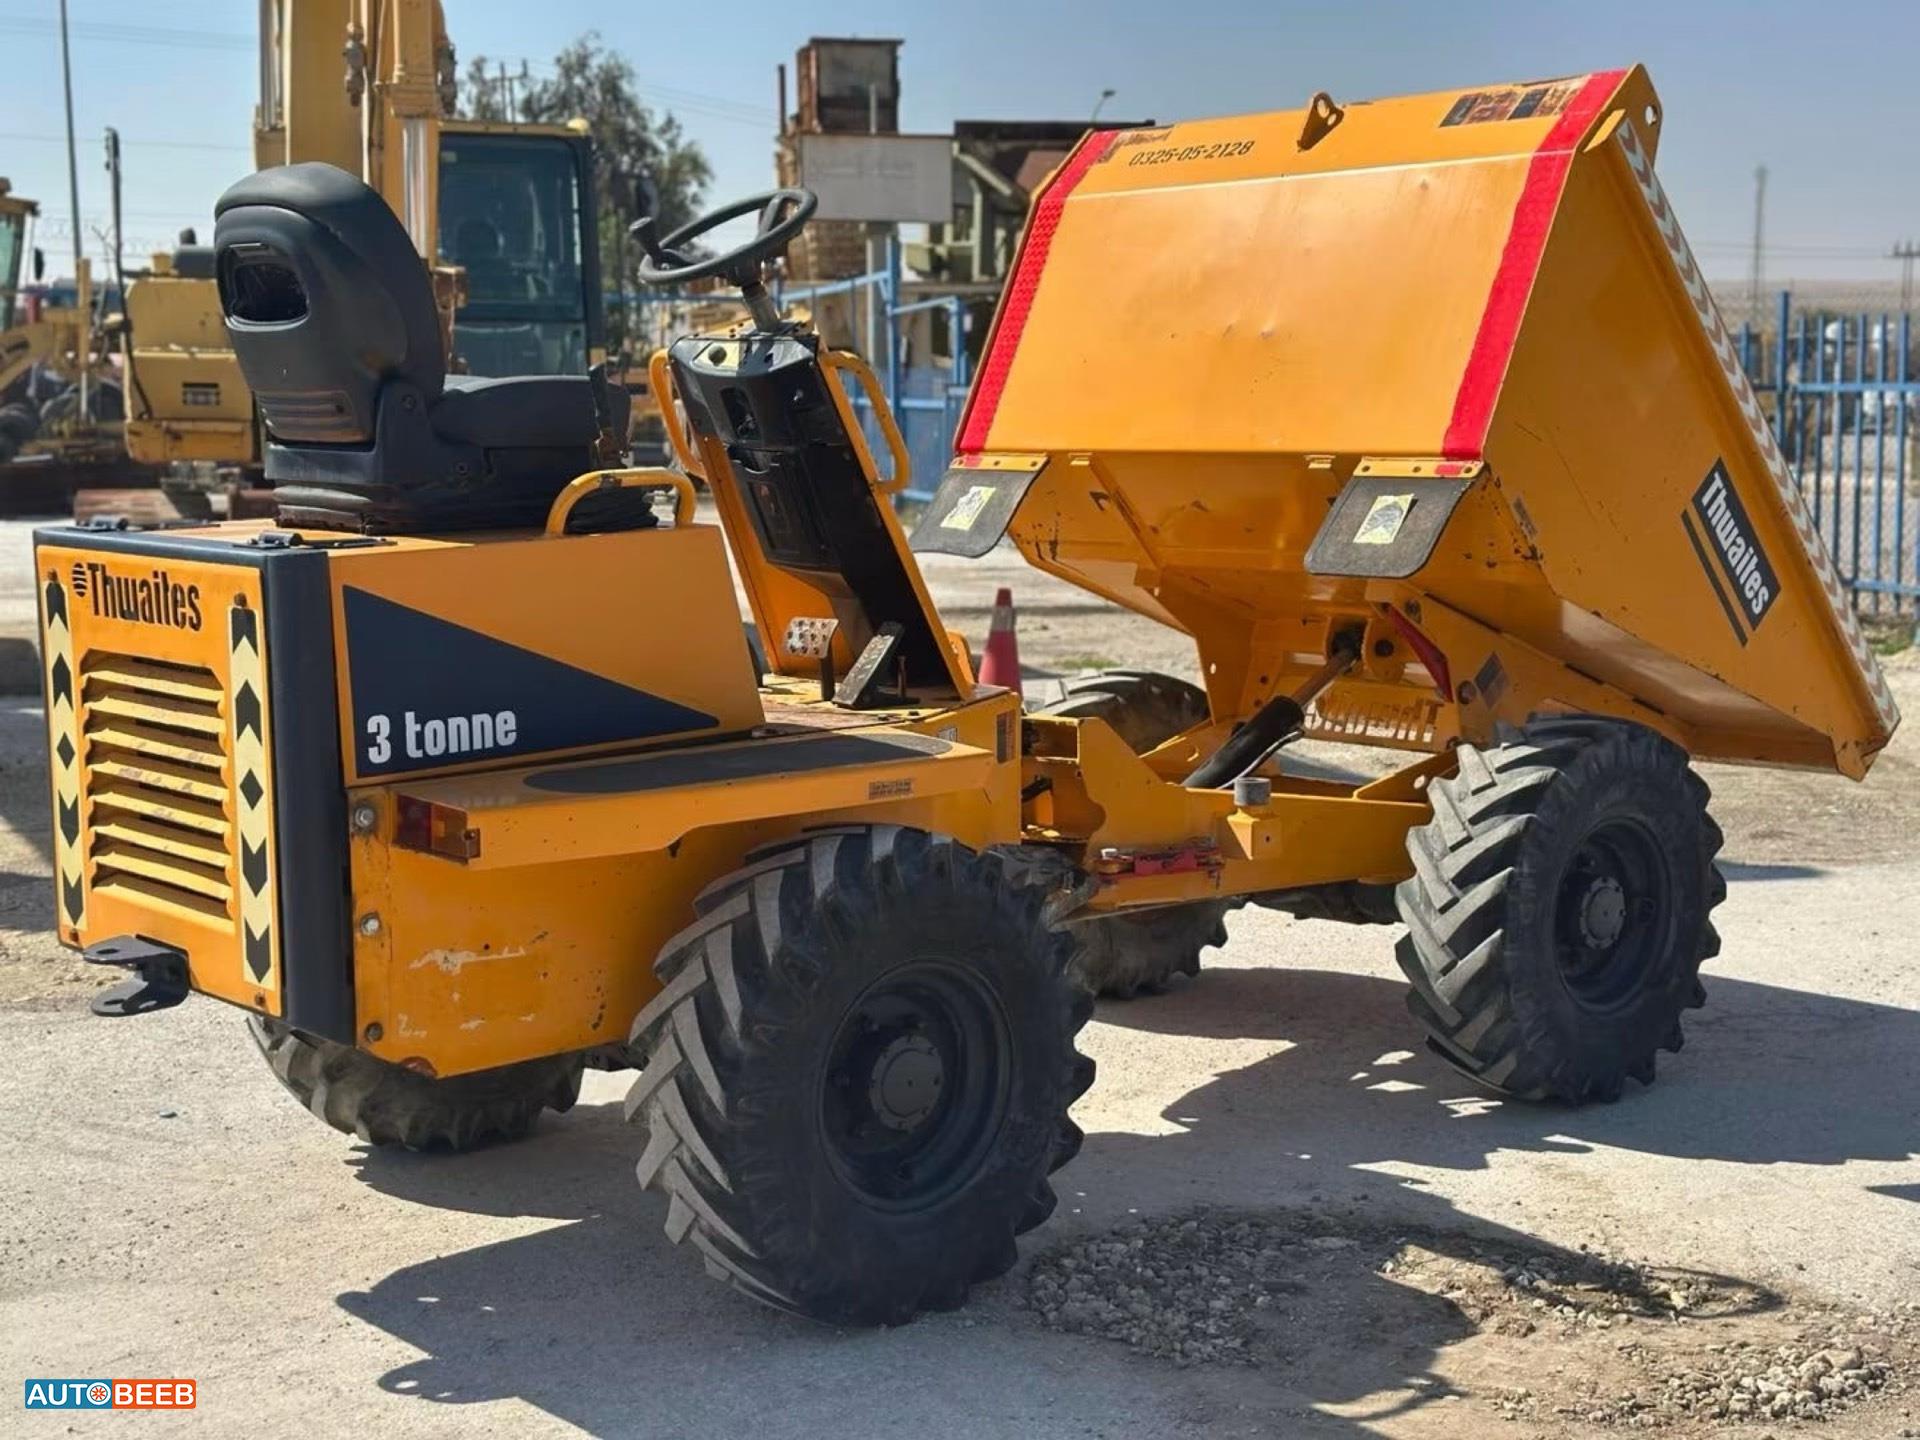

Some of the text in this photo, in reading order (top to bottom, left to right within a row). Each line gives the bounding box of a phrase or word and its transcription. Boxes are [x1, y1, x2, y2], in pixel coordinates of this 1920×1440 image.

[1129, 140, 1255, 167] 0325-05-2128
[1701, 472, 1769, 615] Thwaites
[87, 562, 202, 632] Thwaites
[367, 710, 518, 764] 3 tonne
